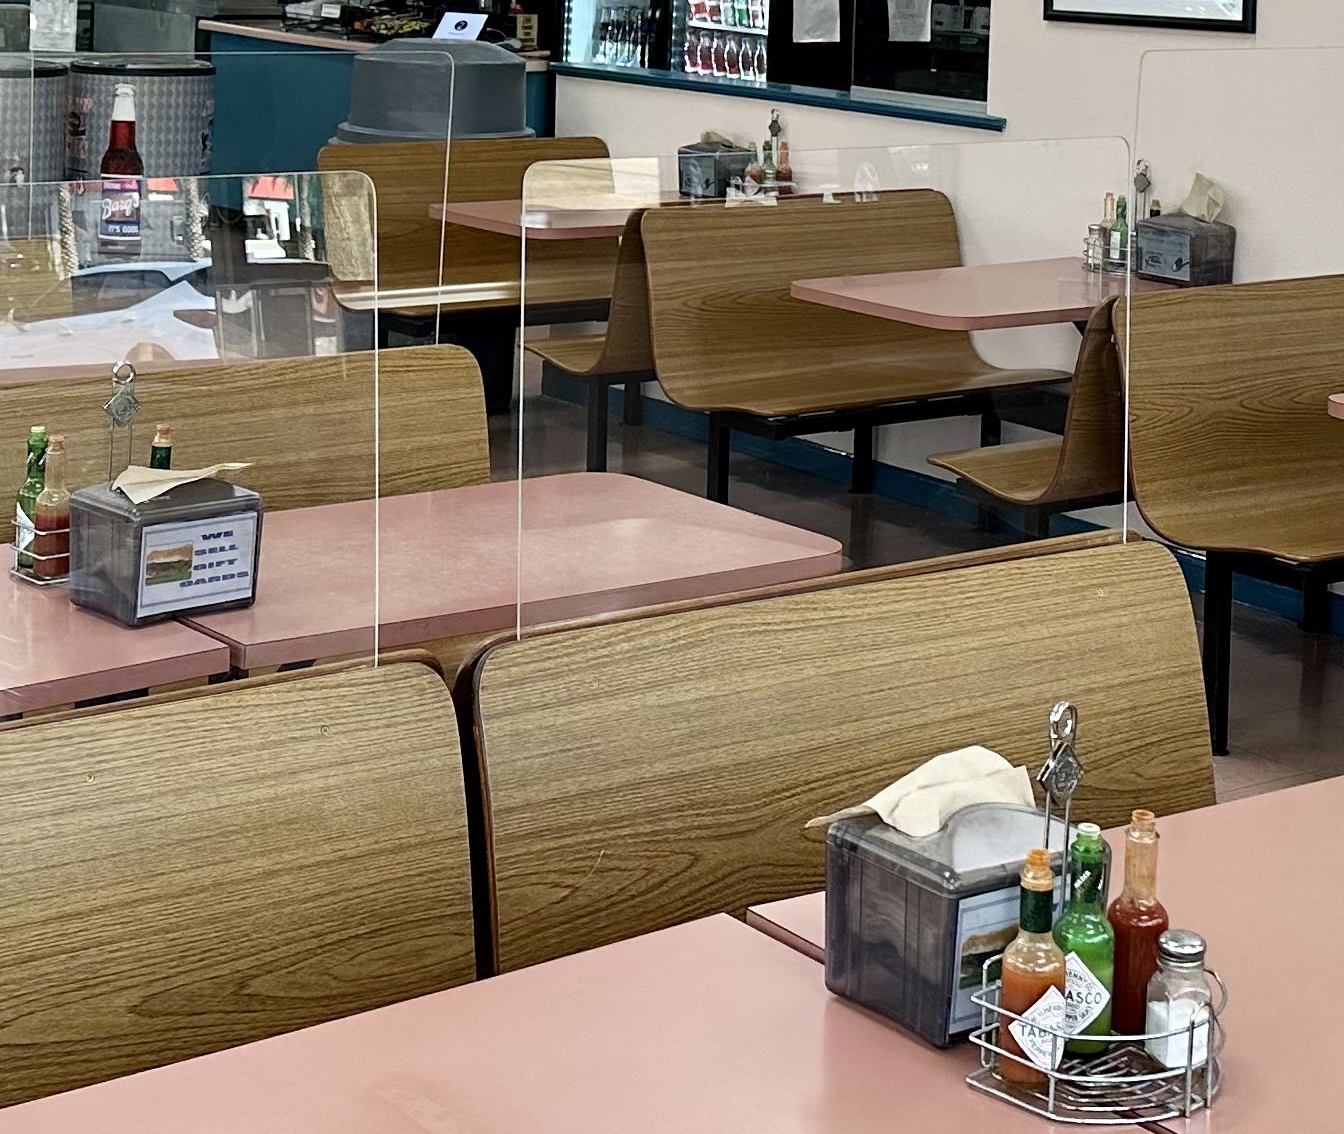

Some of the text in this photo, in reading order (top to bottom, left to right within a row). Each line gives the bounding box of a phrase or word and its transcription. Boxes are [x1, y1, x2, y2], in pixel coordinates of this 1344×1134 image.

[202, 530, 234, 541] WE
[195, 544, 239, 556] SELL
[193, 558, 238, 570] GIFT
[179, 571, 249, 587] CARDS
